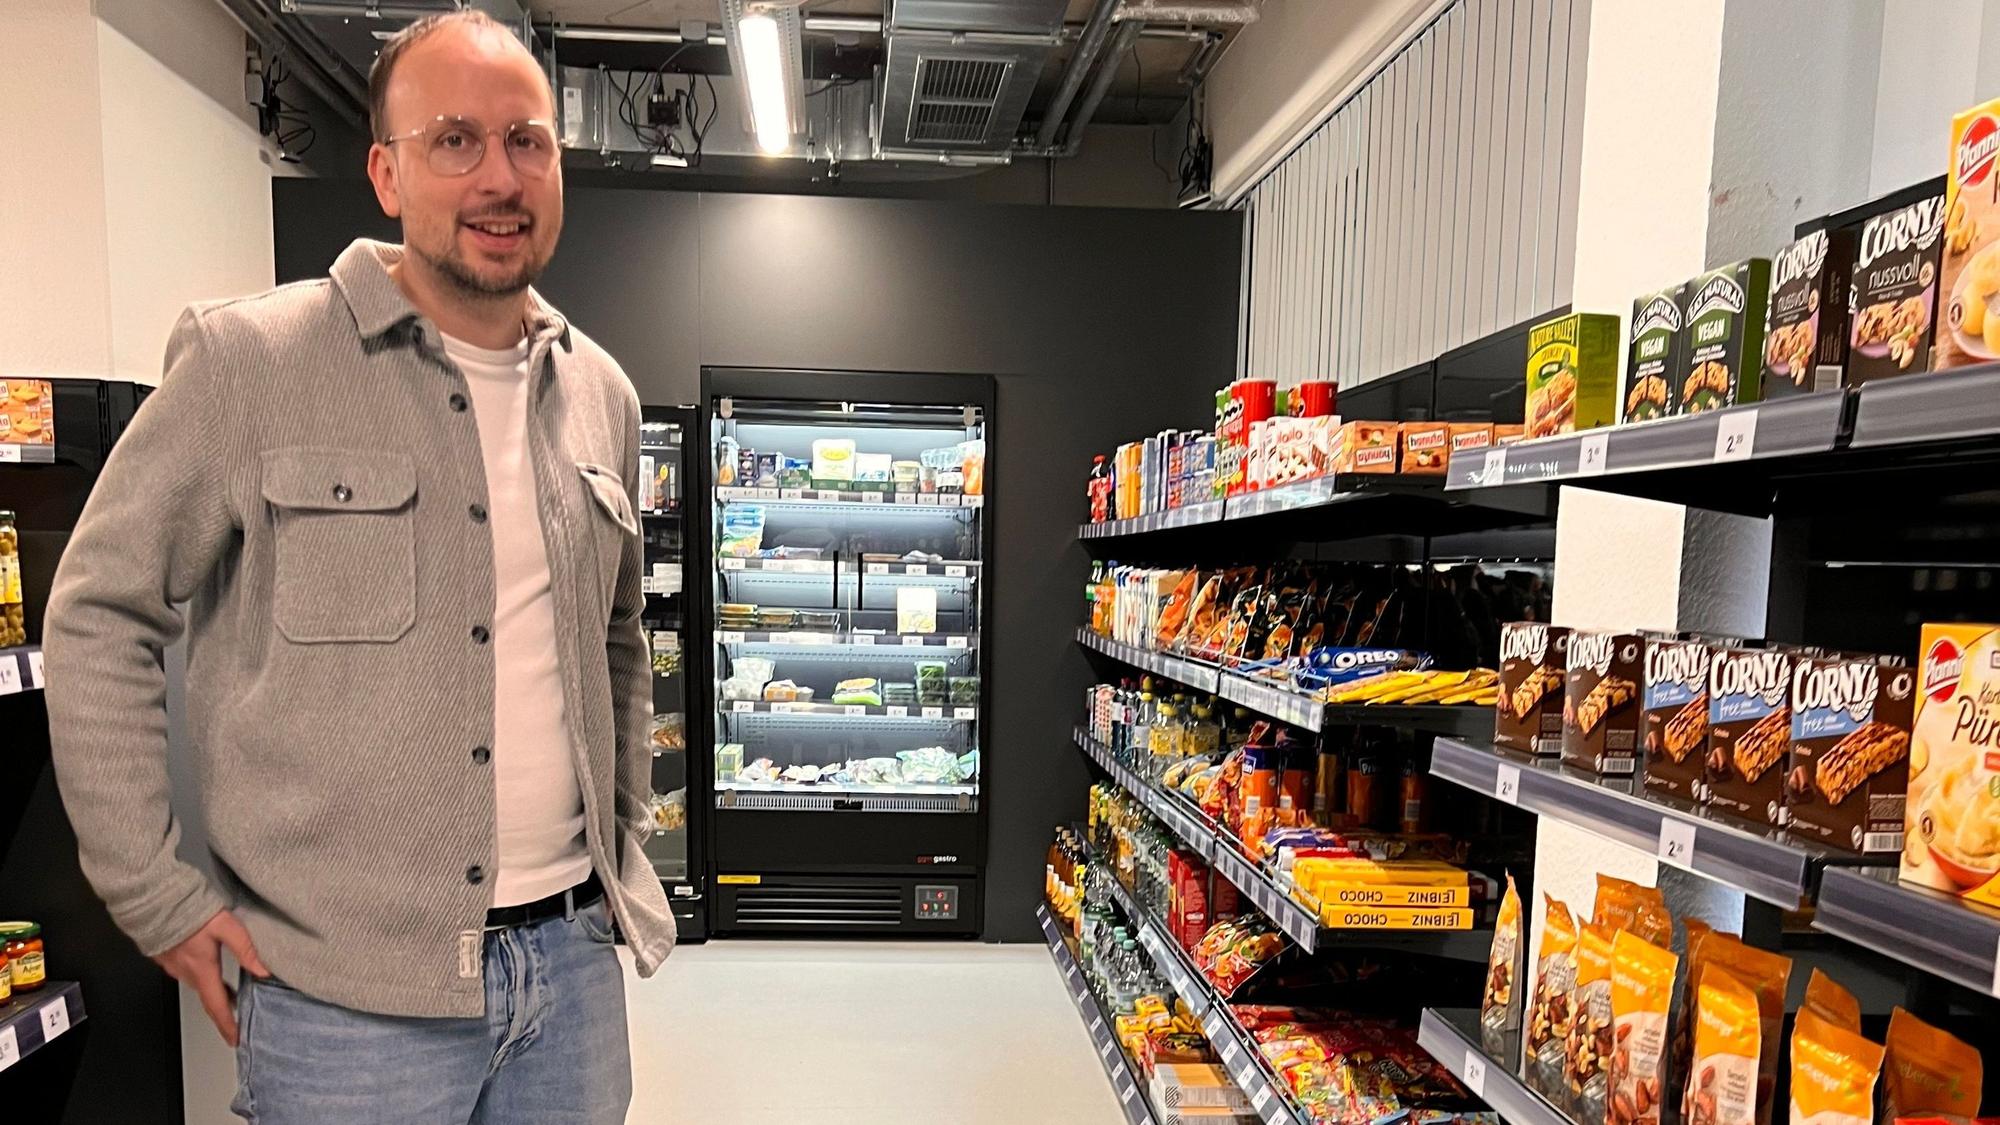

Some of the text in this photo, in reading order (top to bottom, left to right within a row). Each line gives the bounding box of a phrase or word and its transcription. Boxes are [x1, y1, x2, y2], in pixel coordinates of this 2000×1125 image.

[1859, 194, 1945, 269] CORNY
[1772, 228, 1828, 294] CORNY
[1868, 253, 1920, 289] nussvoll
[1703, 279, 1741, 308] NATURAL
[1647, 299, 1678, 328] NATURAL
[1554, 317, 1578, 344] VALLEY
[1698, 318, 1725, 342] VEGAN
[1640, 336, 1665, 359] VEGAN
[1410, 433, 1442, 447] hanuta
[1455, 432, 1487, 447] hanuta
[1500, 624, 1548, 663] CORNY
[1566, 631, 1613, 673] CORNY
[1335, 650, 1399, 668] OREO
[1644, 641, 1709, 688] CORNY
[1709, 650, 1790, 701] CORNY
[1792, 659, 1878, 714] CORNY
[1653, 685, 1670, 706] free
[1720, 699, 1741, 720] free
[1801, 712, 1824, 736] free
[1340, 889, 1456, 904] LEIBNIZ CHOCO
[1344, 913, 1460, 926] LEIBNIZ CHOCO
